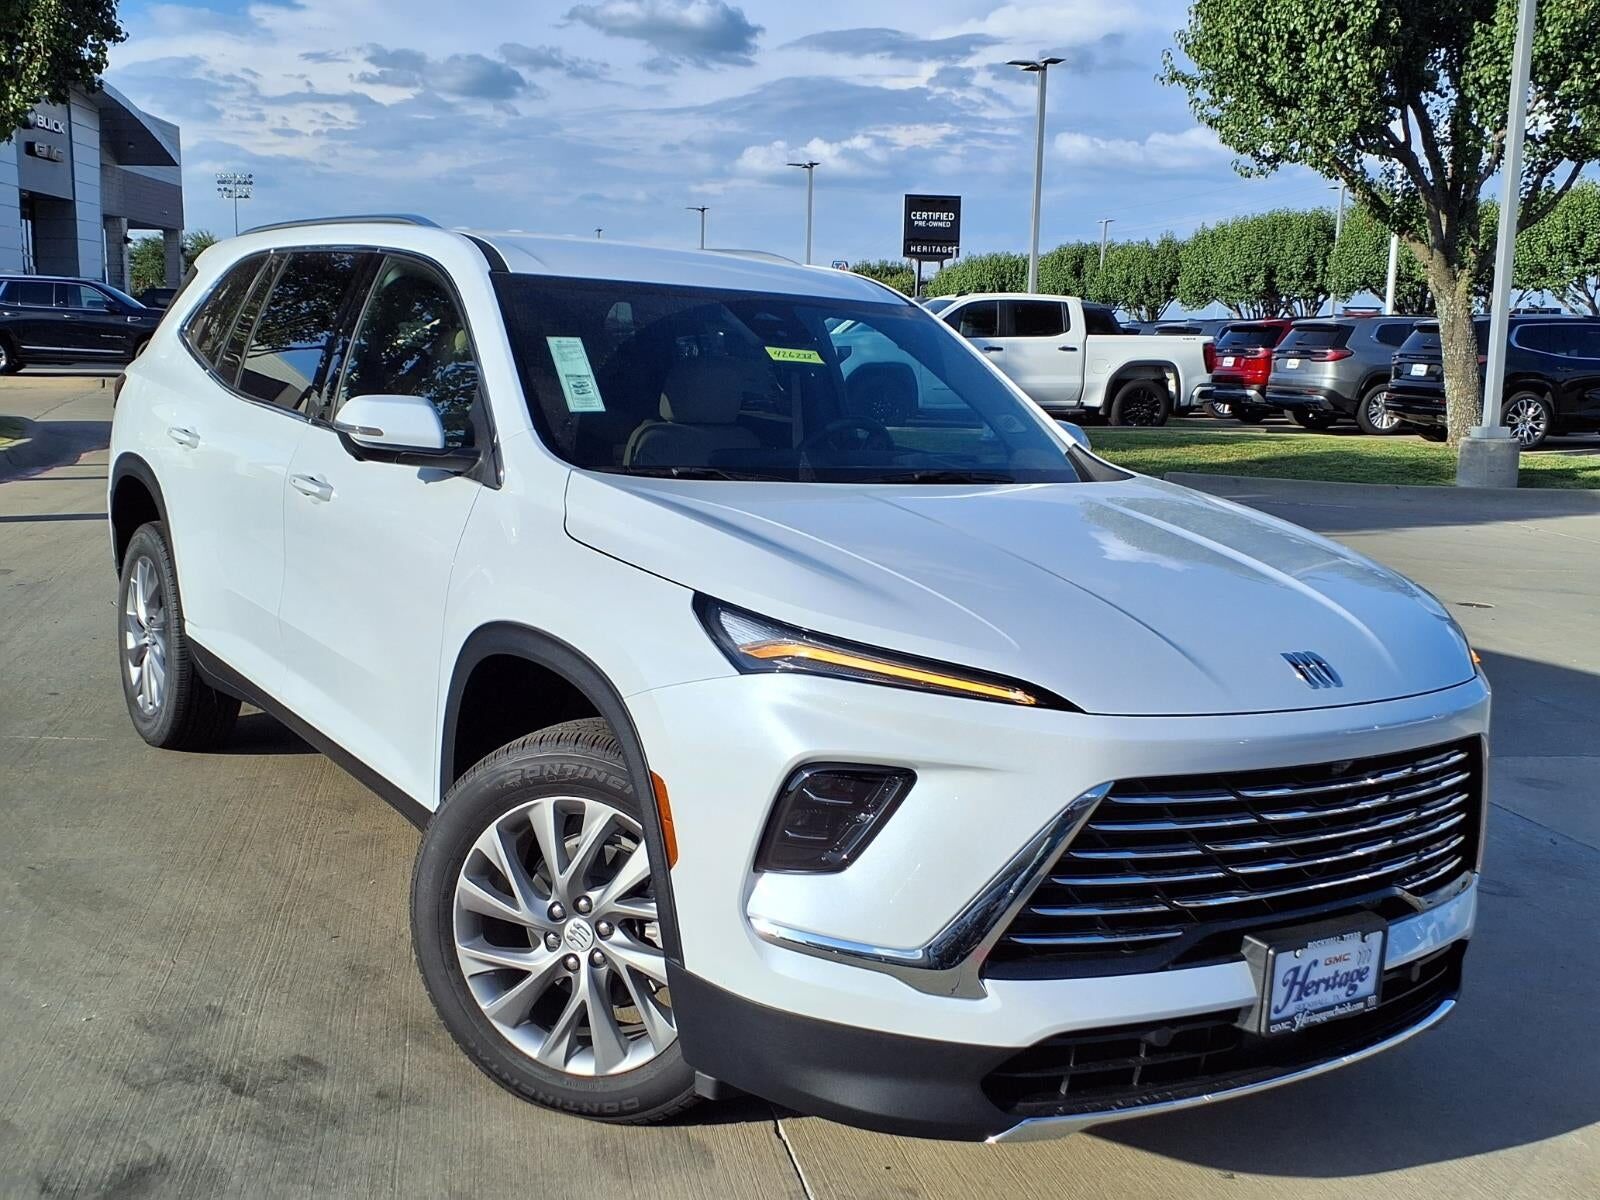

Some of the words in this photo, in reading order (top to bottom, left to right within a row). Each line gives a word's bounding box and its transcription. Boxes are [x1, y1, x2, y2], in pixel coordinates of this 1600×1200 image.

[37, 114, 65, 134] BUICK
[910, 211, 955, 221] CERTIFIED
[914, 220, 951, 228] PRE-OWNED
[910, 245, 953, 253] HERITAGE
[1324, 953, 1350, 966] GMC
[1274, 959, 1370, 1014] Heritage
[1270, 1021, 1291, 1033] GMC
